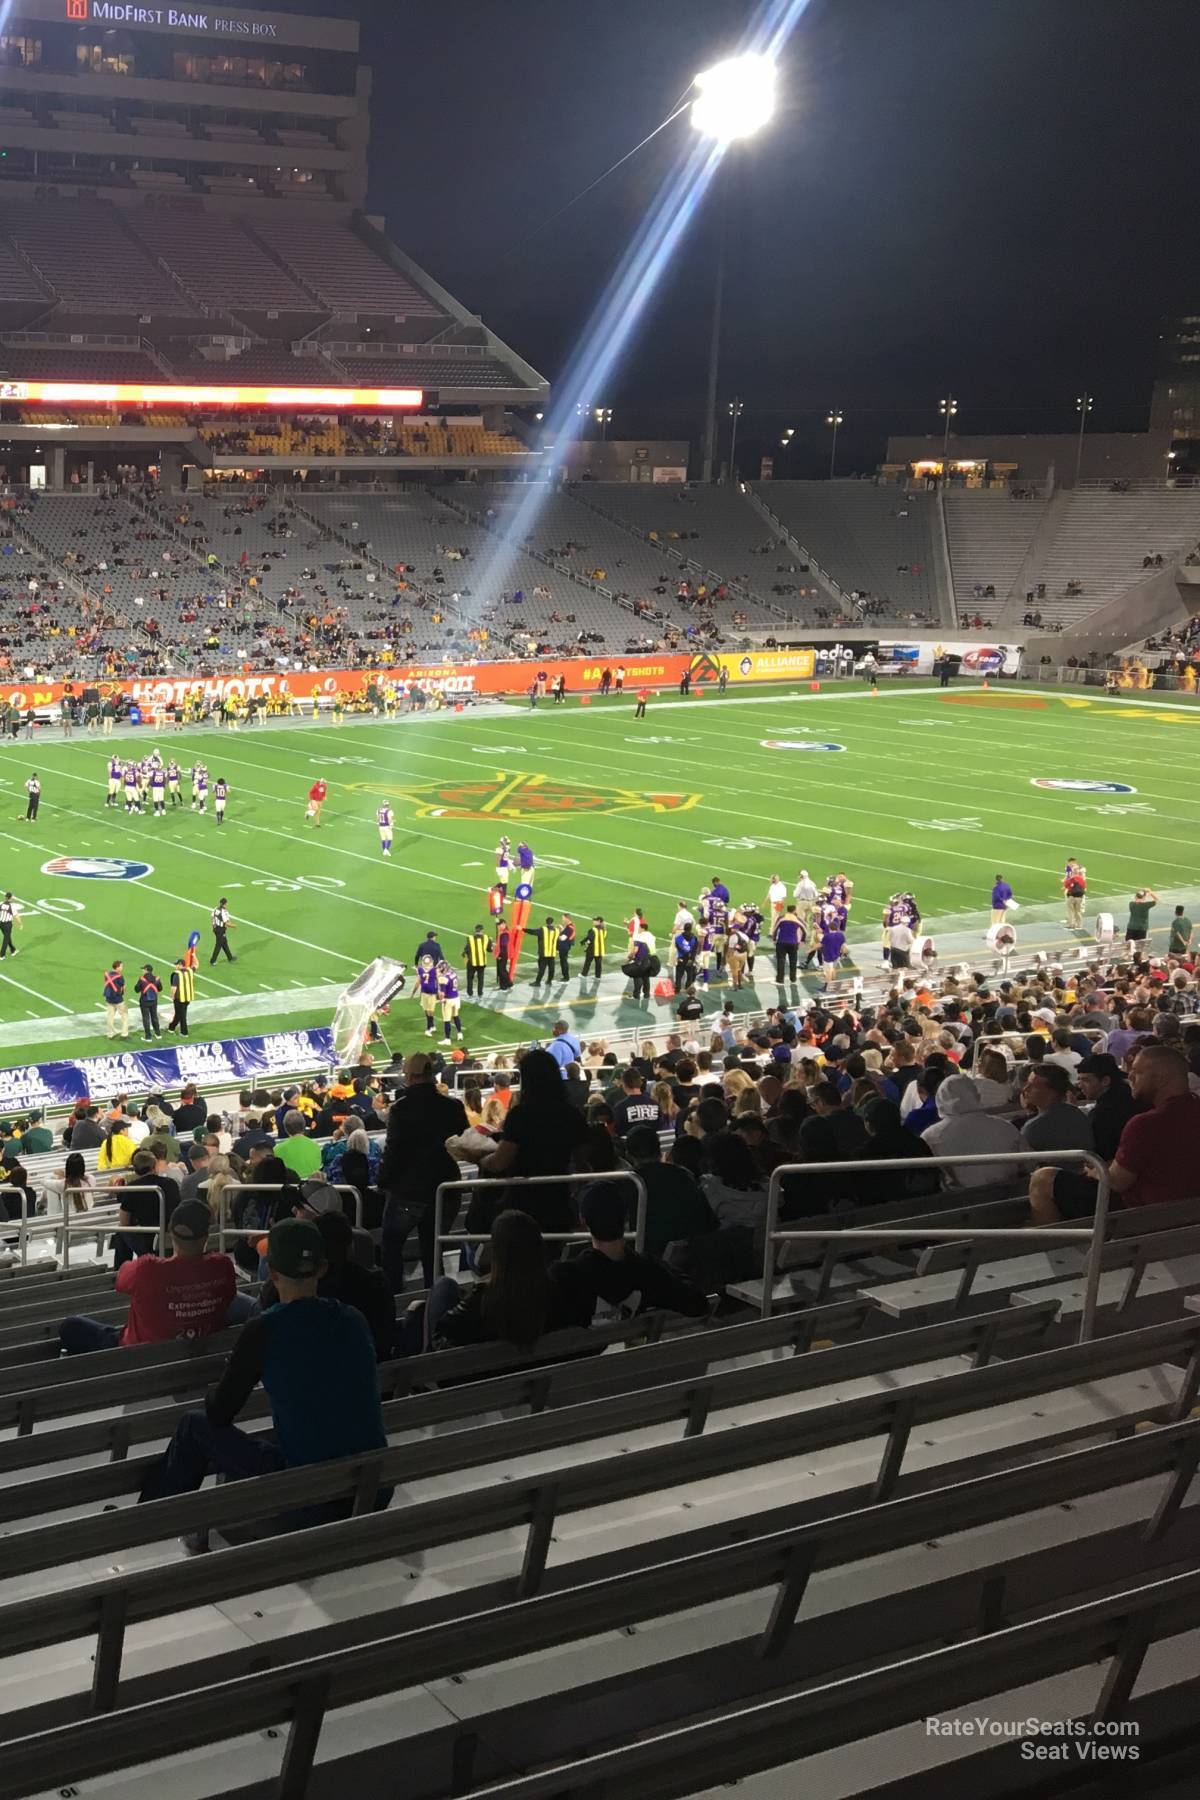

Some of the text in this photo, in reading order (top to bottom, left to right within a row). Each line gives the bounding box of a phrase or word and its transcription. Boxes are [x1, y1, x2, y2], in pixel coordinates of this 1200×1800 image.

[167, 9, 208, 29] BANK
[214, 18, 251, 34] PRESS
[252, 22, 279, 37] BOX
[251, 874, 347, 892] 30
[263, 1035, 298, 1050] NAVY
[175, 1045, 210, 1060] NAVY
[265, 1045, 320, 1063] FEDERAL
[84, 1055, 120, 1070] NAVY
[178, 1054, 233, 1074] FEDERAL
[86, 1066, 145, 1083] FEDERAL
[627, 1106, 659, 1121] FIRE
[60, 1787, 79, 1798] 10
